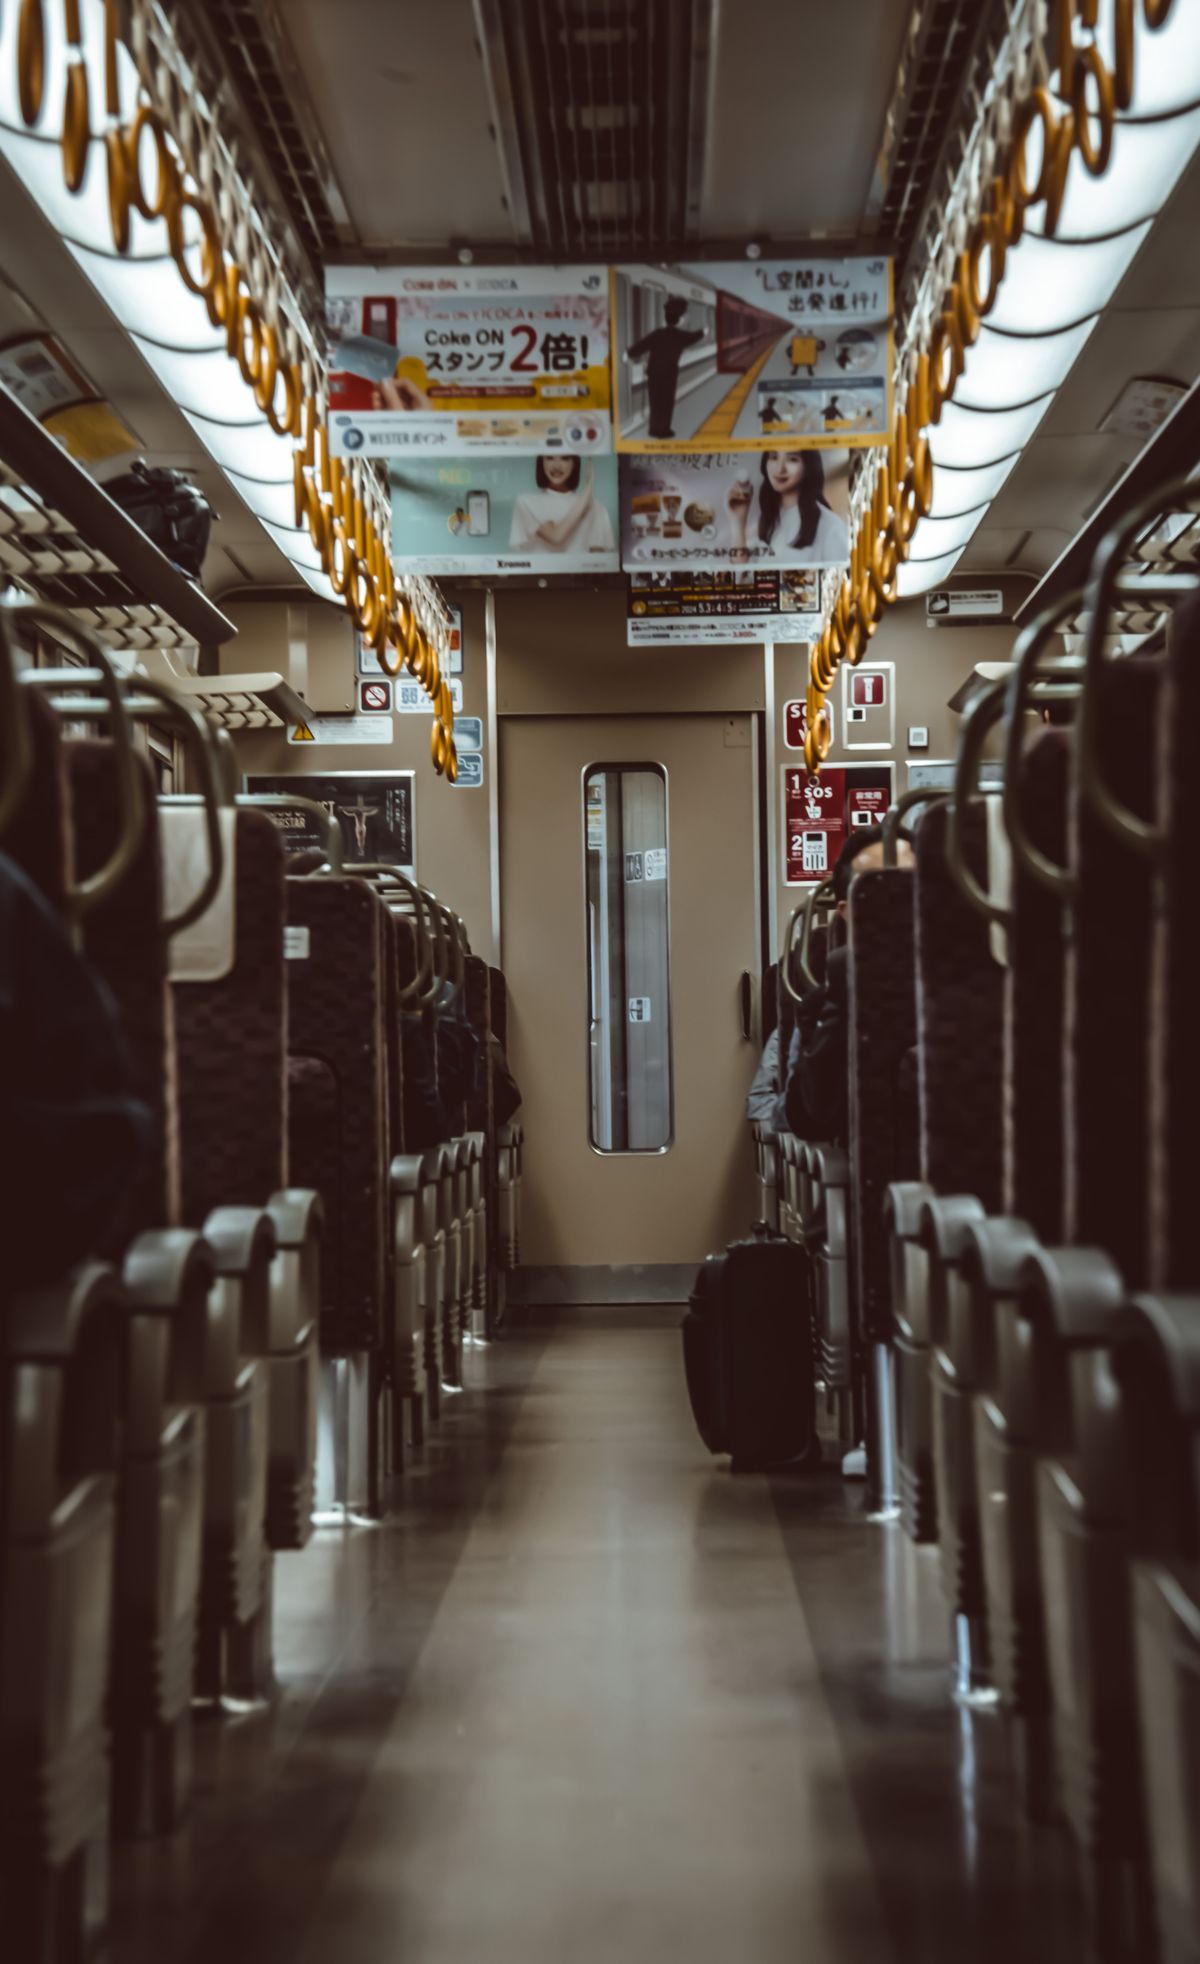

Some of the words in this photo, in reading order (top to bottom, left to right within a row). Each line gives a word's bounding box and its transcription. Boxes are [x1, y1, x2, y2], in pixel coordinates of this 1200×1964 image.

[424, 329, 471, 346] Coke
[476, 329, 504, 346] ON
[425, 351, 505, 372] スタンプ
[791, 774, 800, 790] 1
[804, 787, 833, 798] SOS
[791, 834, 803, 851] 2
